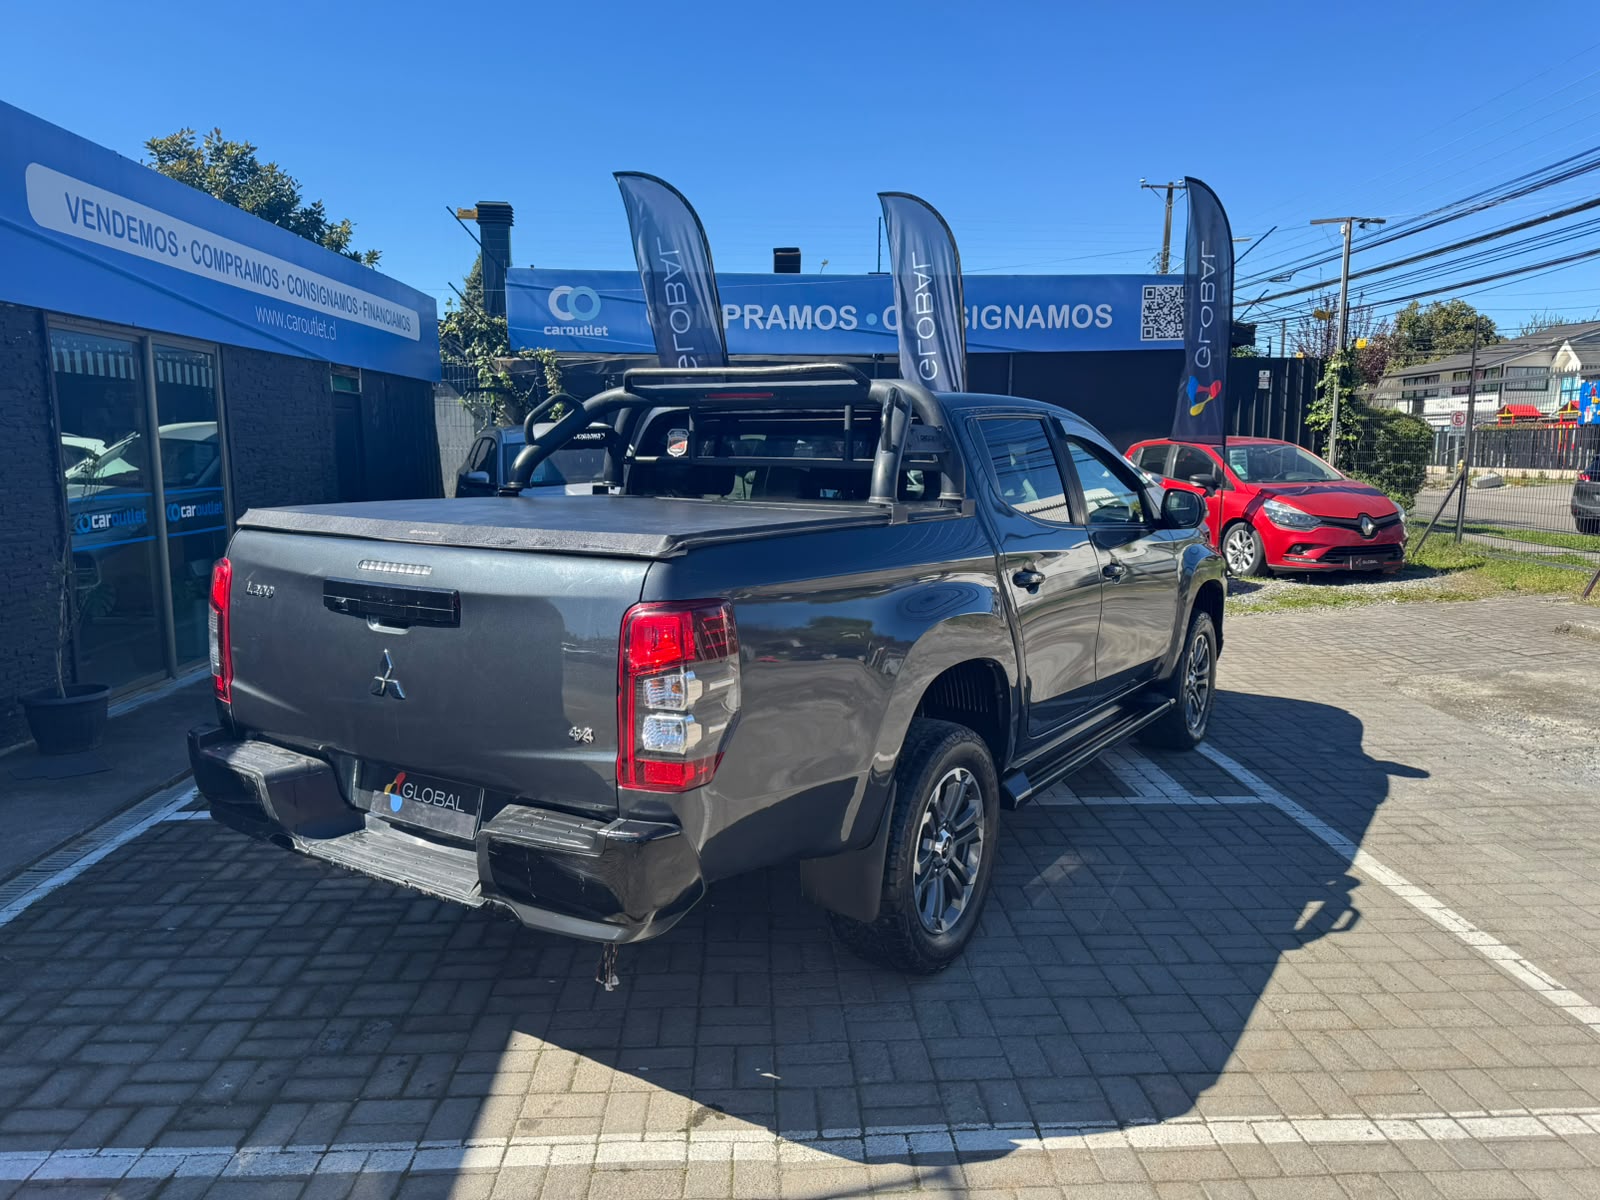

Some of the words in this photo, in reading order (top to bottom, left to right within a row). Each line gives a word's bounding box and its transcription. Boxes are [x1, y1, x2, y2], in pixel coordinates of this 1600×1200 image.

[65, 192, 179, 257] VENDEMOS
[191, 240, 280, 290] COMPRAMOS
[287, 274, 359, 316] CONSIGNAMOS
[363, 305, 411, 333] FINANCIAMOS
[254, 305, 338, 342] www.caroutlet.cl
[543, 324, 609, 337] caroutlet
[645, 304, 858, 331] PRAMOS
[882, 303, 1113, 331] CIGNAMOS
[91, 508, 147, 529] caroutlet
[180, 501, 224, 519] caroutlet
[402, 782, 465, 813] GLOBAL
